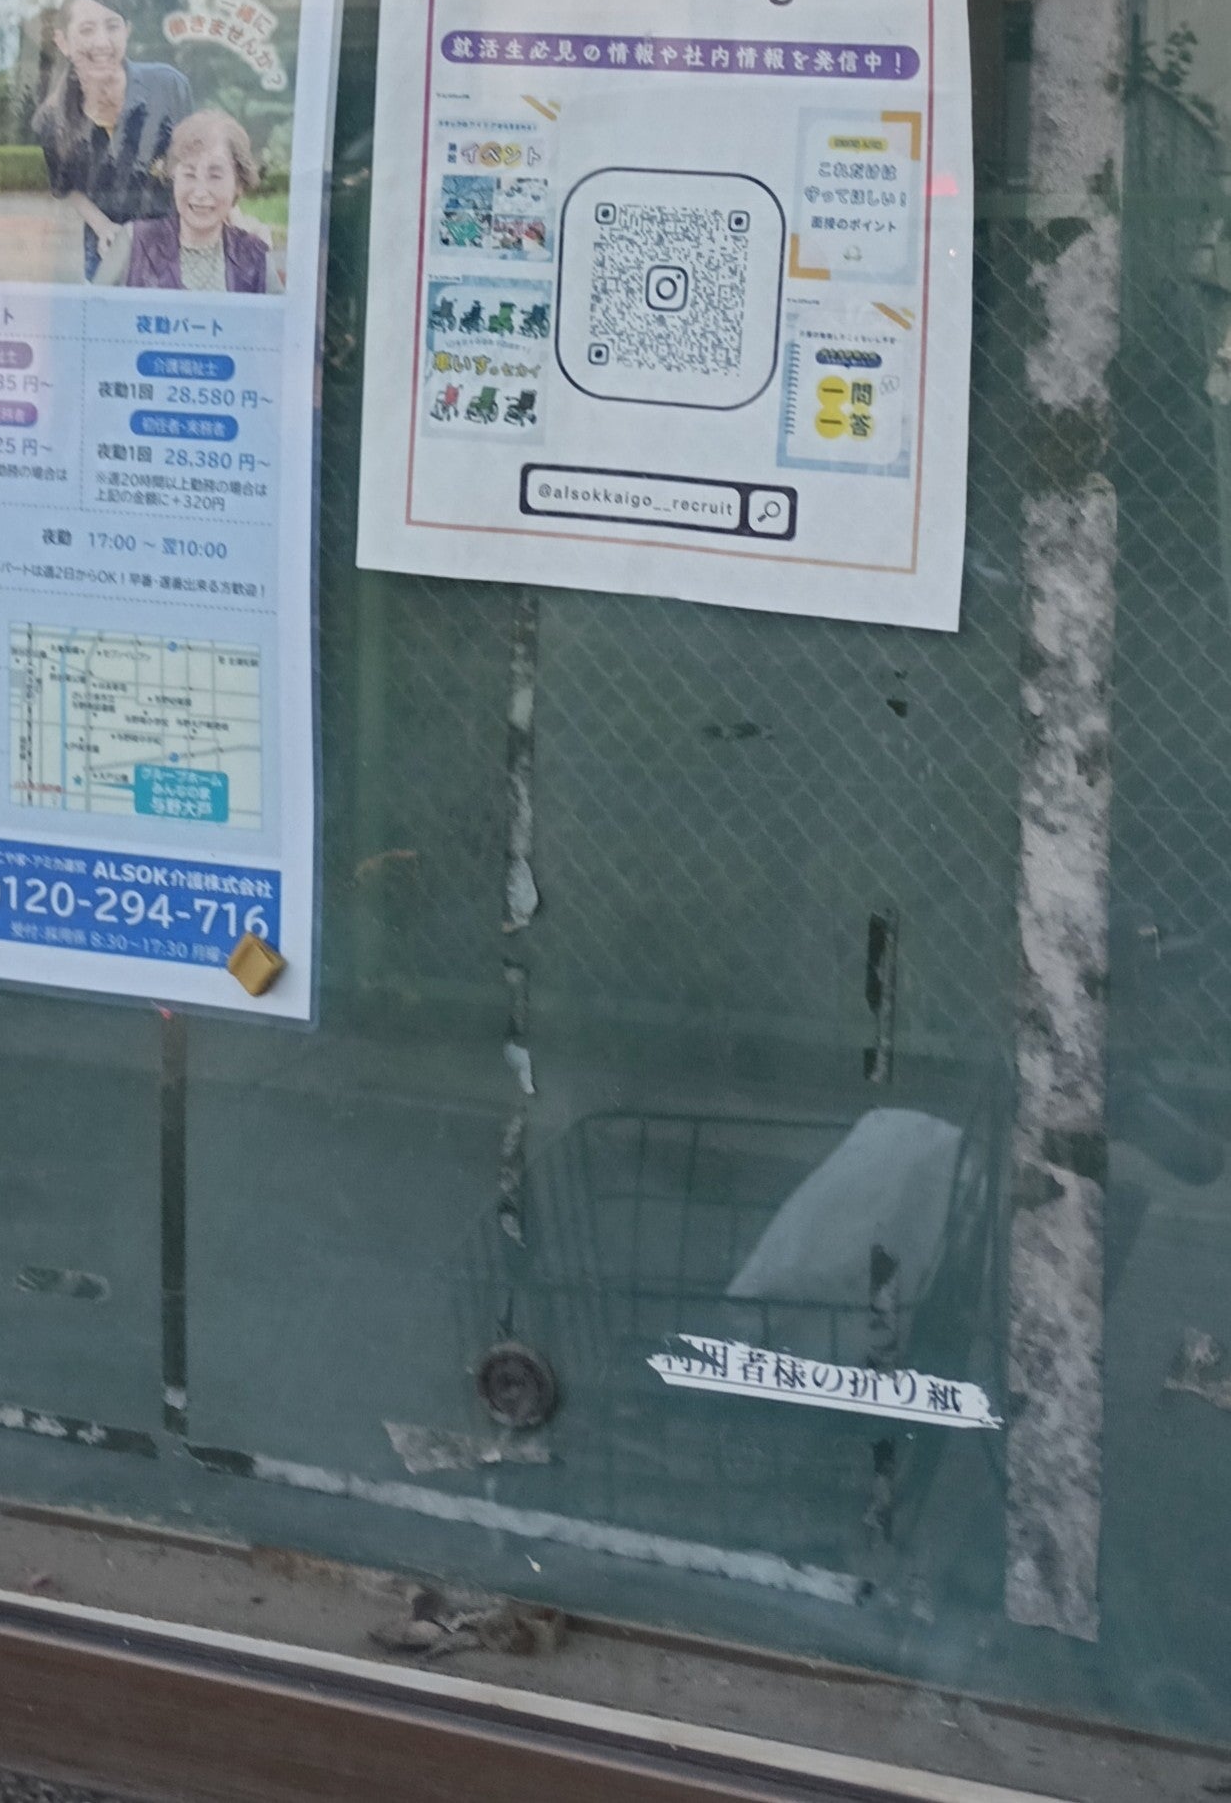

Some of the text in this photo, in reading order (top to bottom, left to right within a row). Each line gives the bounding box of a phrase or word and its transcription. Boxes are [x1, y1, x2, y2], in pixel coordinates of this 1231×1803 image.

[135, 313, 224, 338] 夜勤パート
[41, 527, 73, 548] 夜勤
[93, 859, 273, 900] ALSOK介護株式会社
